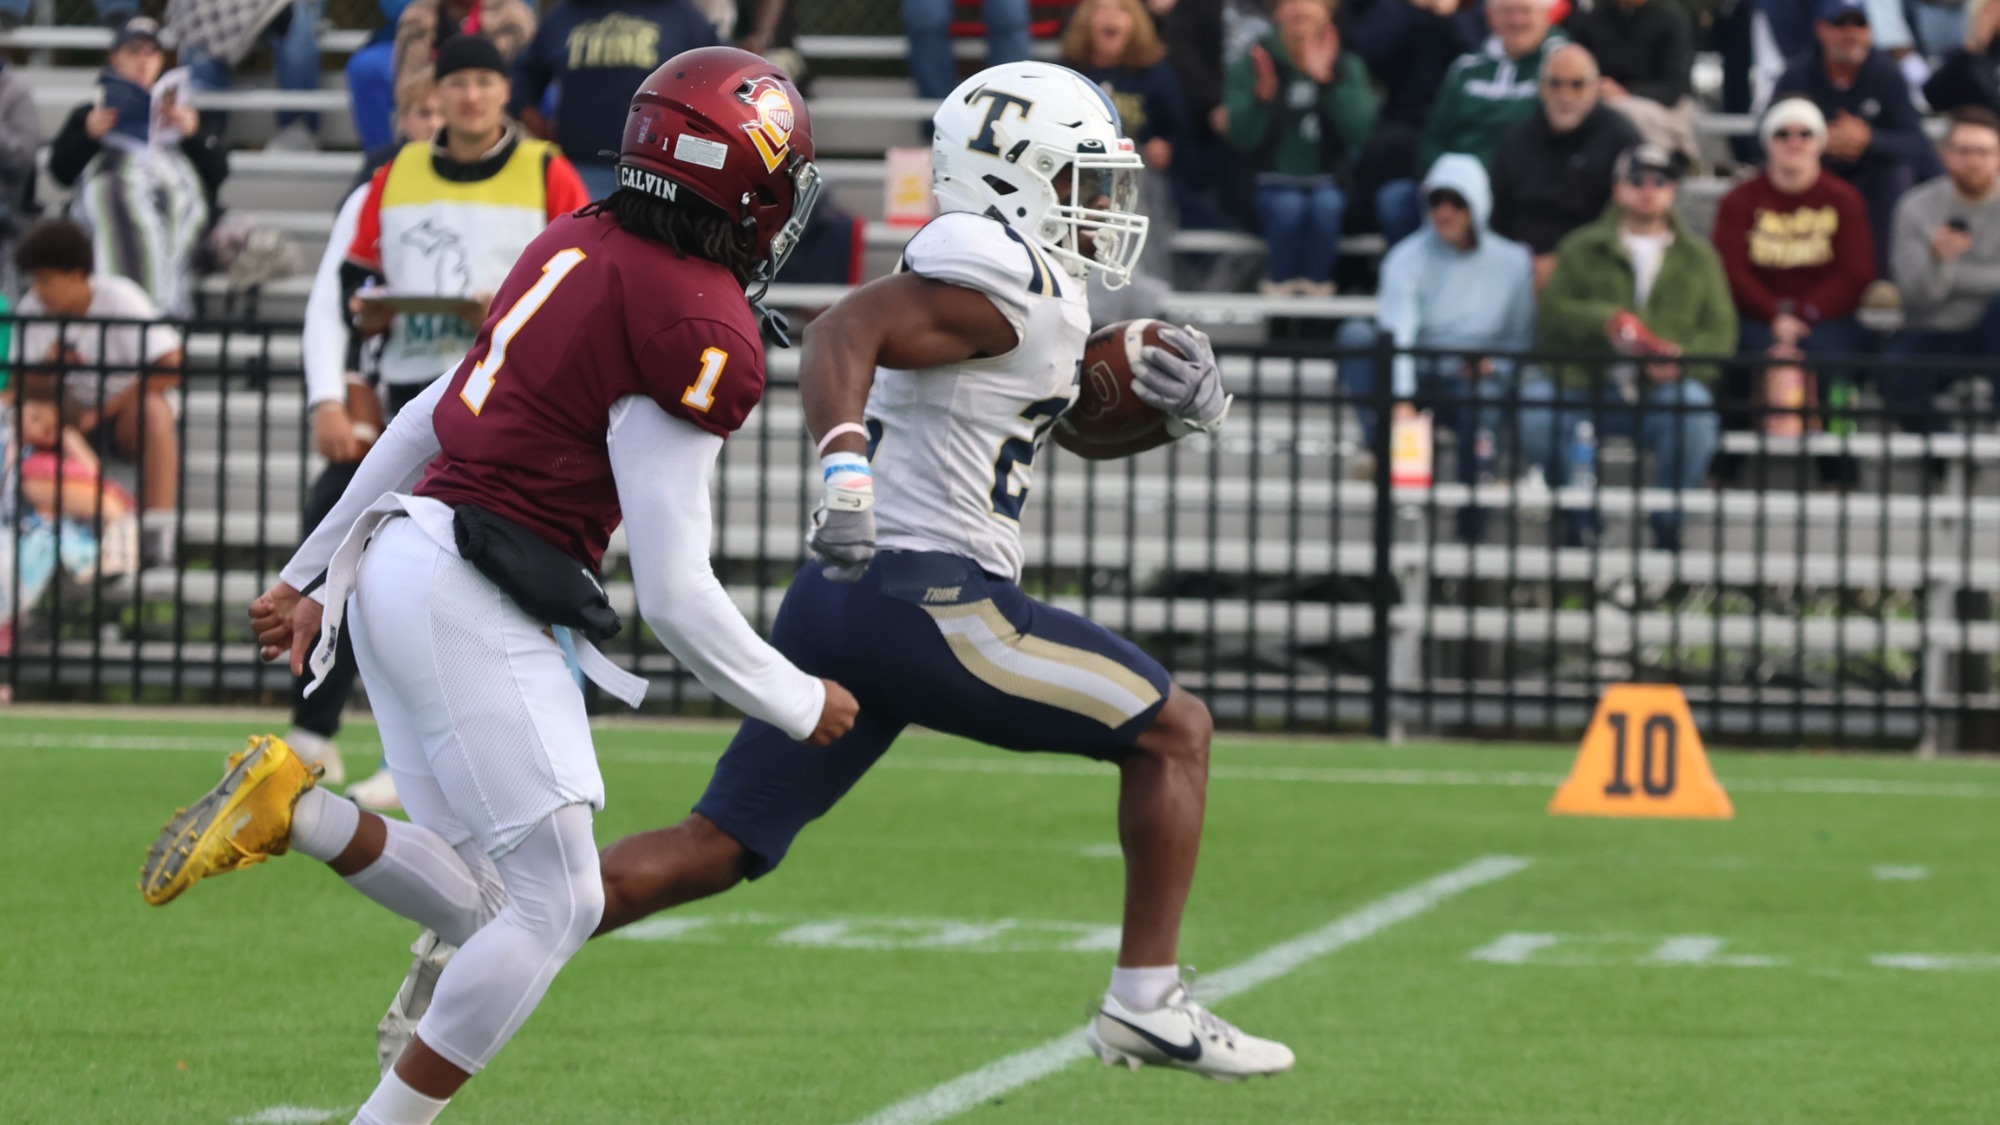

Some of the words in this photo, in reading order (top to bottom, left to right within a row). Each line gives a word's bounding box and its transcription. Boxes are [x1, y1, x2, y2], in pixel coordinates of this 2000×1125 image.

[661, 137, 669, 151] 1
[967, 88, 1034, 158] T
[621, 167, 678, 202] CALVIN
[459, 247, 587, 417] 1
[681, 346, 729, 413] 1
[923, 586, 962, 602] TRINE
[1604, 713, 1676, 797] 10
